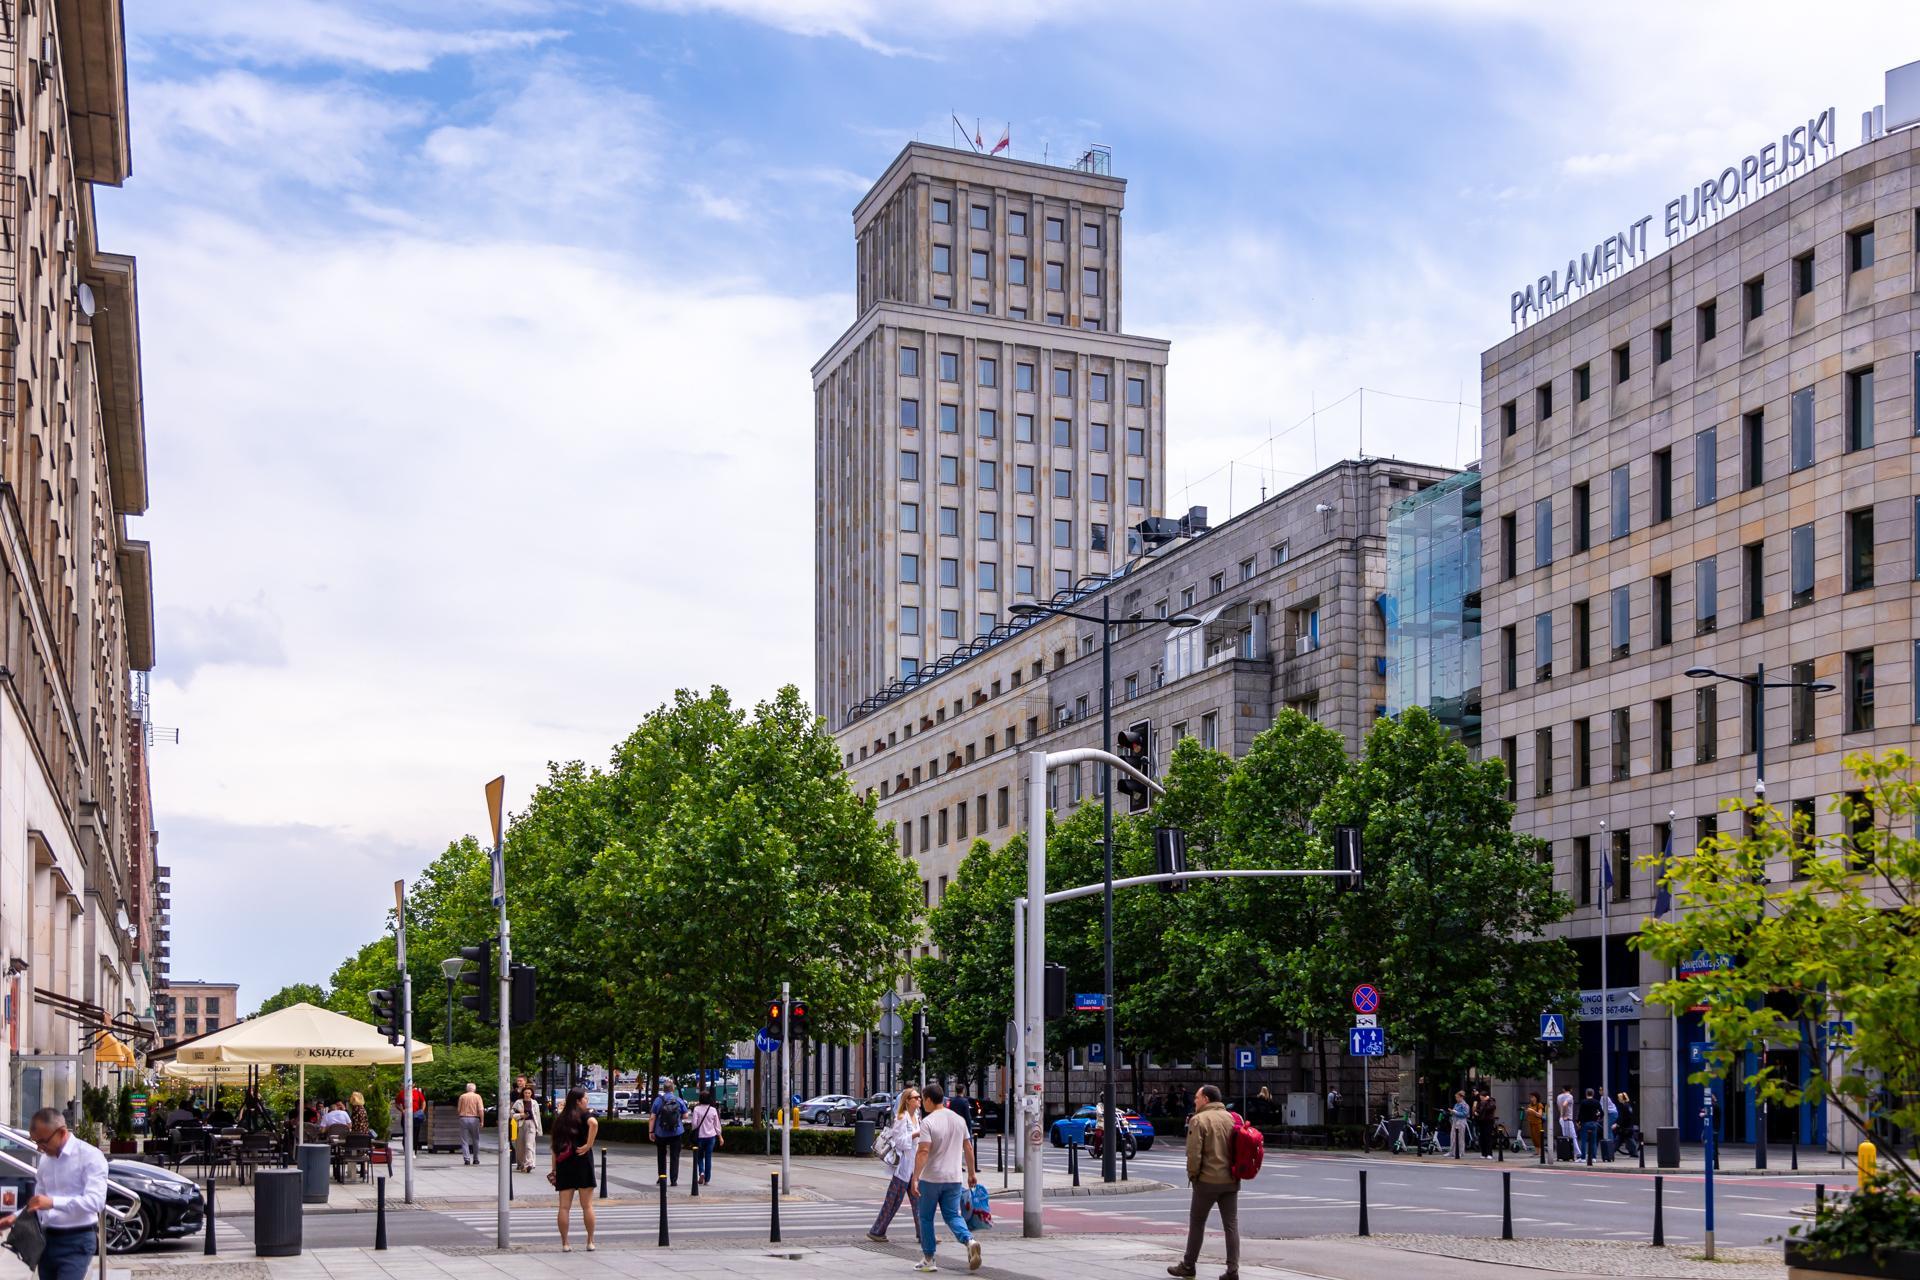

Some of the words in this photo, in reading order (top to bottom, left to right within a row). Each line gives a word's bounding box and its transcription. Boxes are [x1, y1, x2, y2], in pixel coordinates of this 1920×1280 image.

[1511, 215, 1652, 324] PARLAMENT
[1665, 107, 1835, 237] EUROPEJSKI
[309, 1048, 355, 1059] KSIĄŻĘCE
[1240, 1051, 1252, 1068] P
